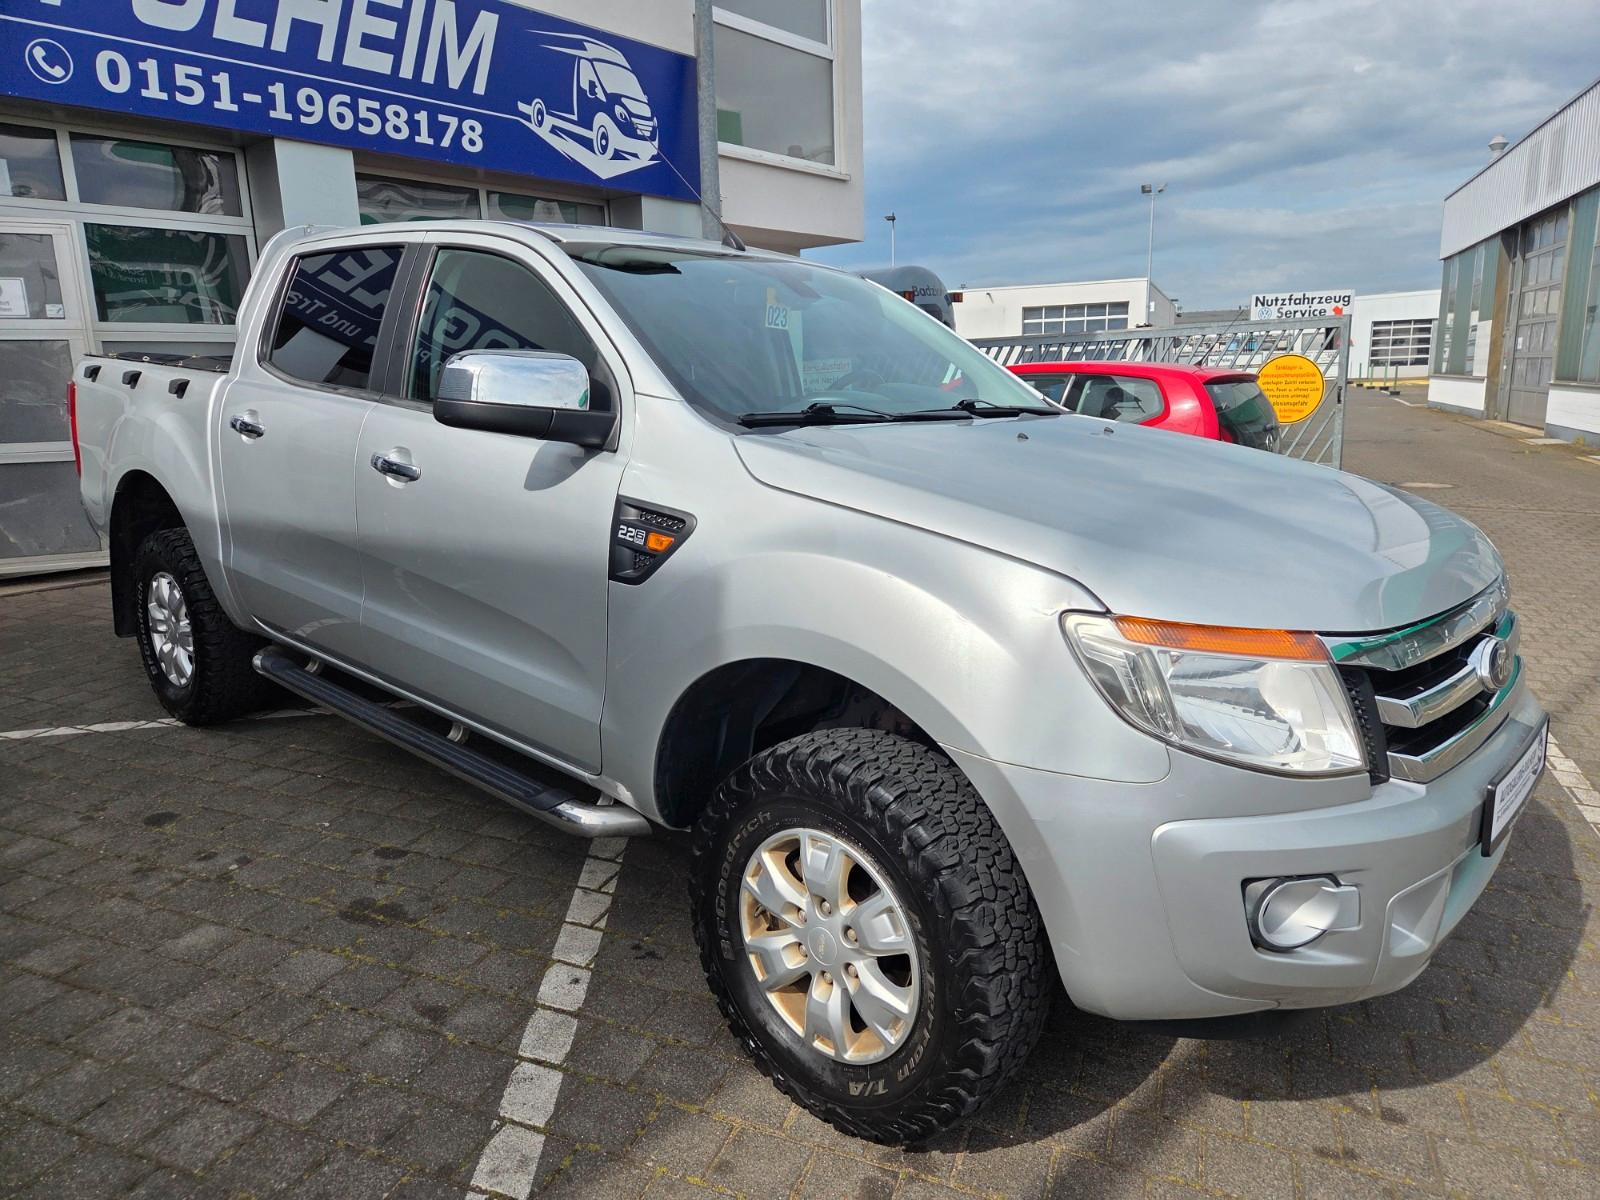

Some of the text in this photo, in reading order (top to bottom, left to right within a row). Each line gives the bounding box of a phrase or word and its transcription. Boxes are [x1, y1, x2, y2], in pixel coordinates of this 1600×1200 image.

[40, 0, 499, 95] LHEIM
[95, 50, 483, 153] 0151-19658178
[1255, 293, 1351, 307] Nutzfahrzeug
[768, 305, 788, 327] 023
[1277, 306, 1327, 318] Service
[848, 1079, 888, 1097] T/A
